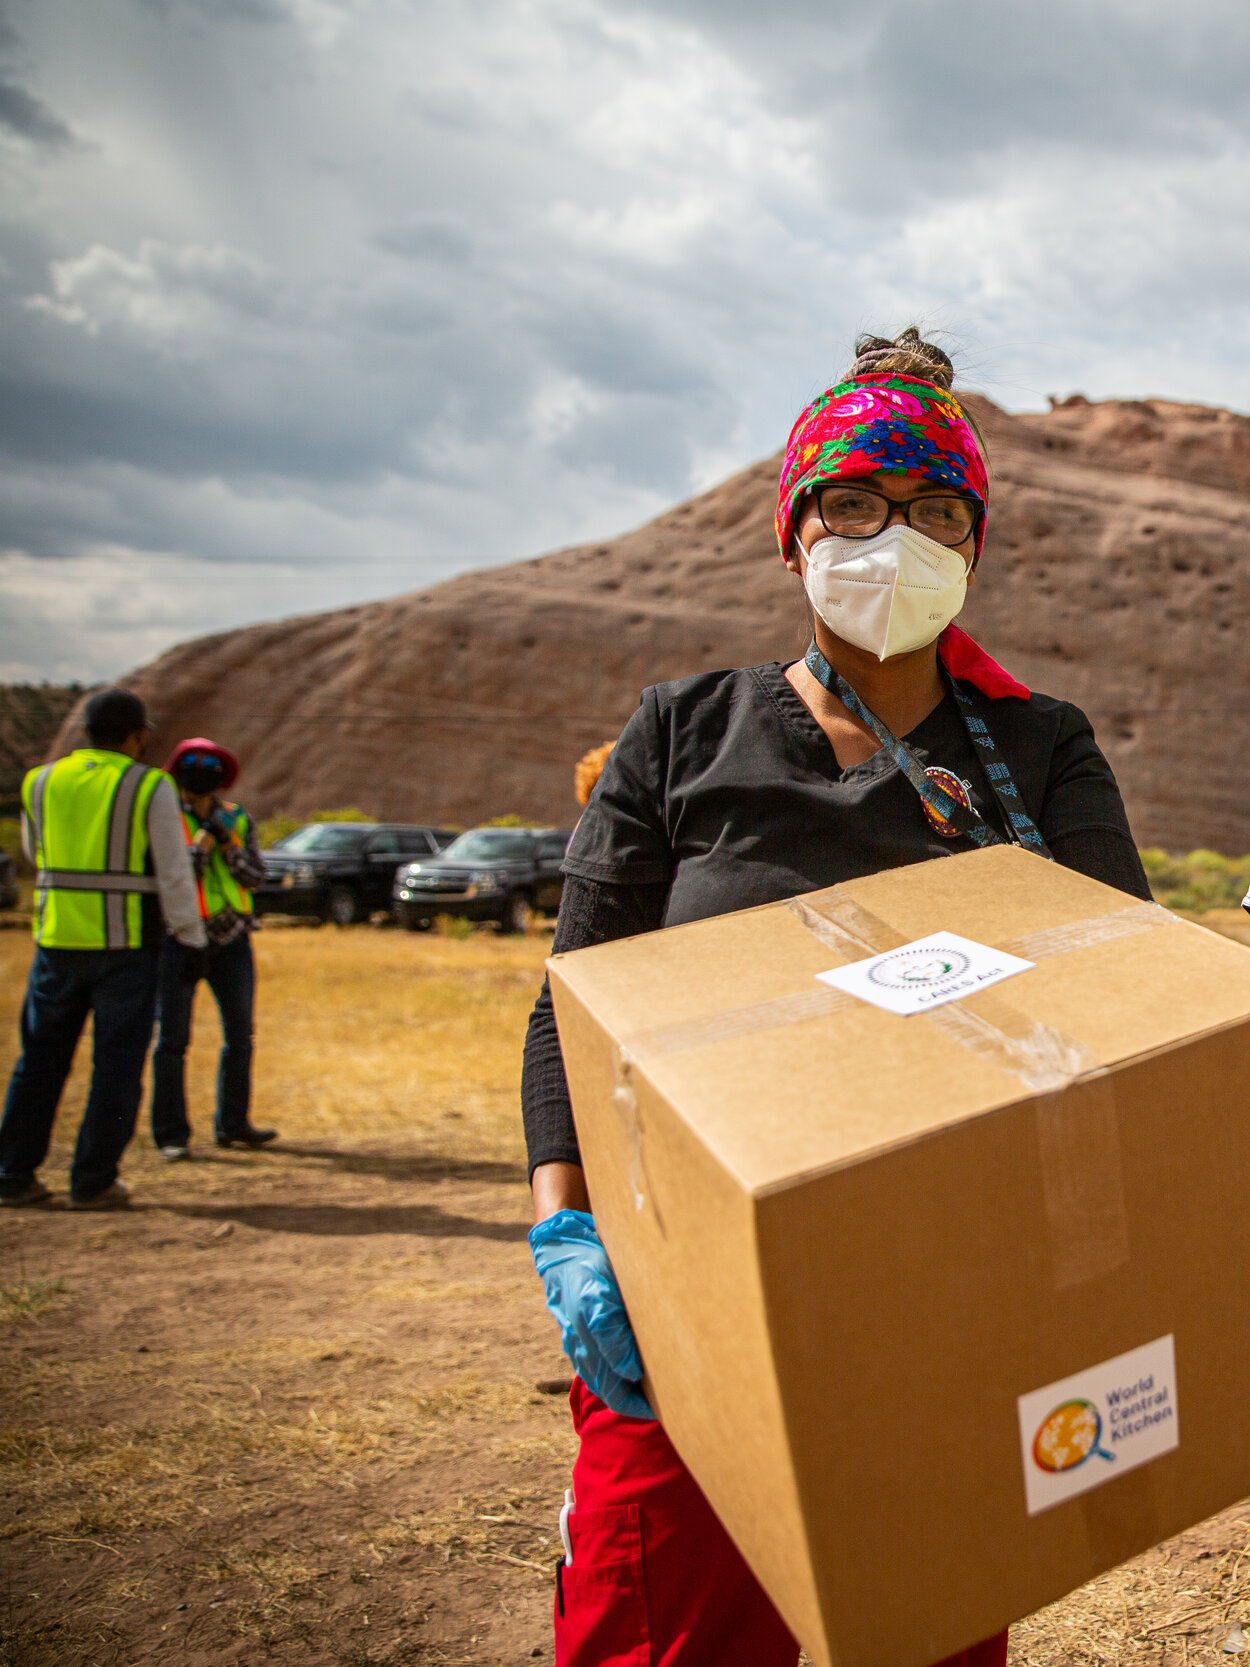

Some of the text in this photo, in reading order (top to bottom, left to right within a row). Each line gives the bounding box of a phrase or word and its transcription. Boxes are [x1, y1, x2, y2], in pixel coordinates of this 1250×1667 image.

[918, 967, 1004, 1002] CARES Act
[1106, 1374, 1153, 1406] World
[1110, 1386, 1168, 1423] Central
[1111, 1406, 1173, 1442] Kitchen
